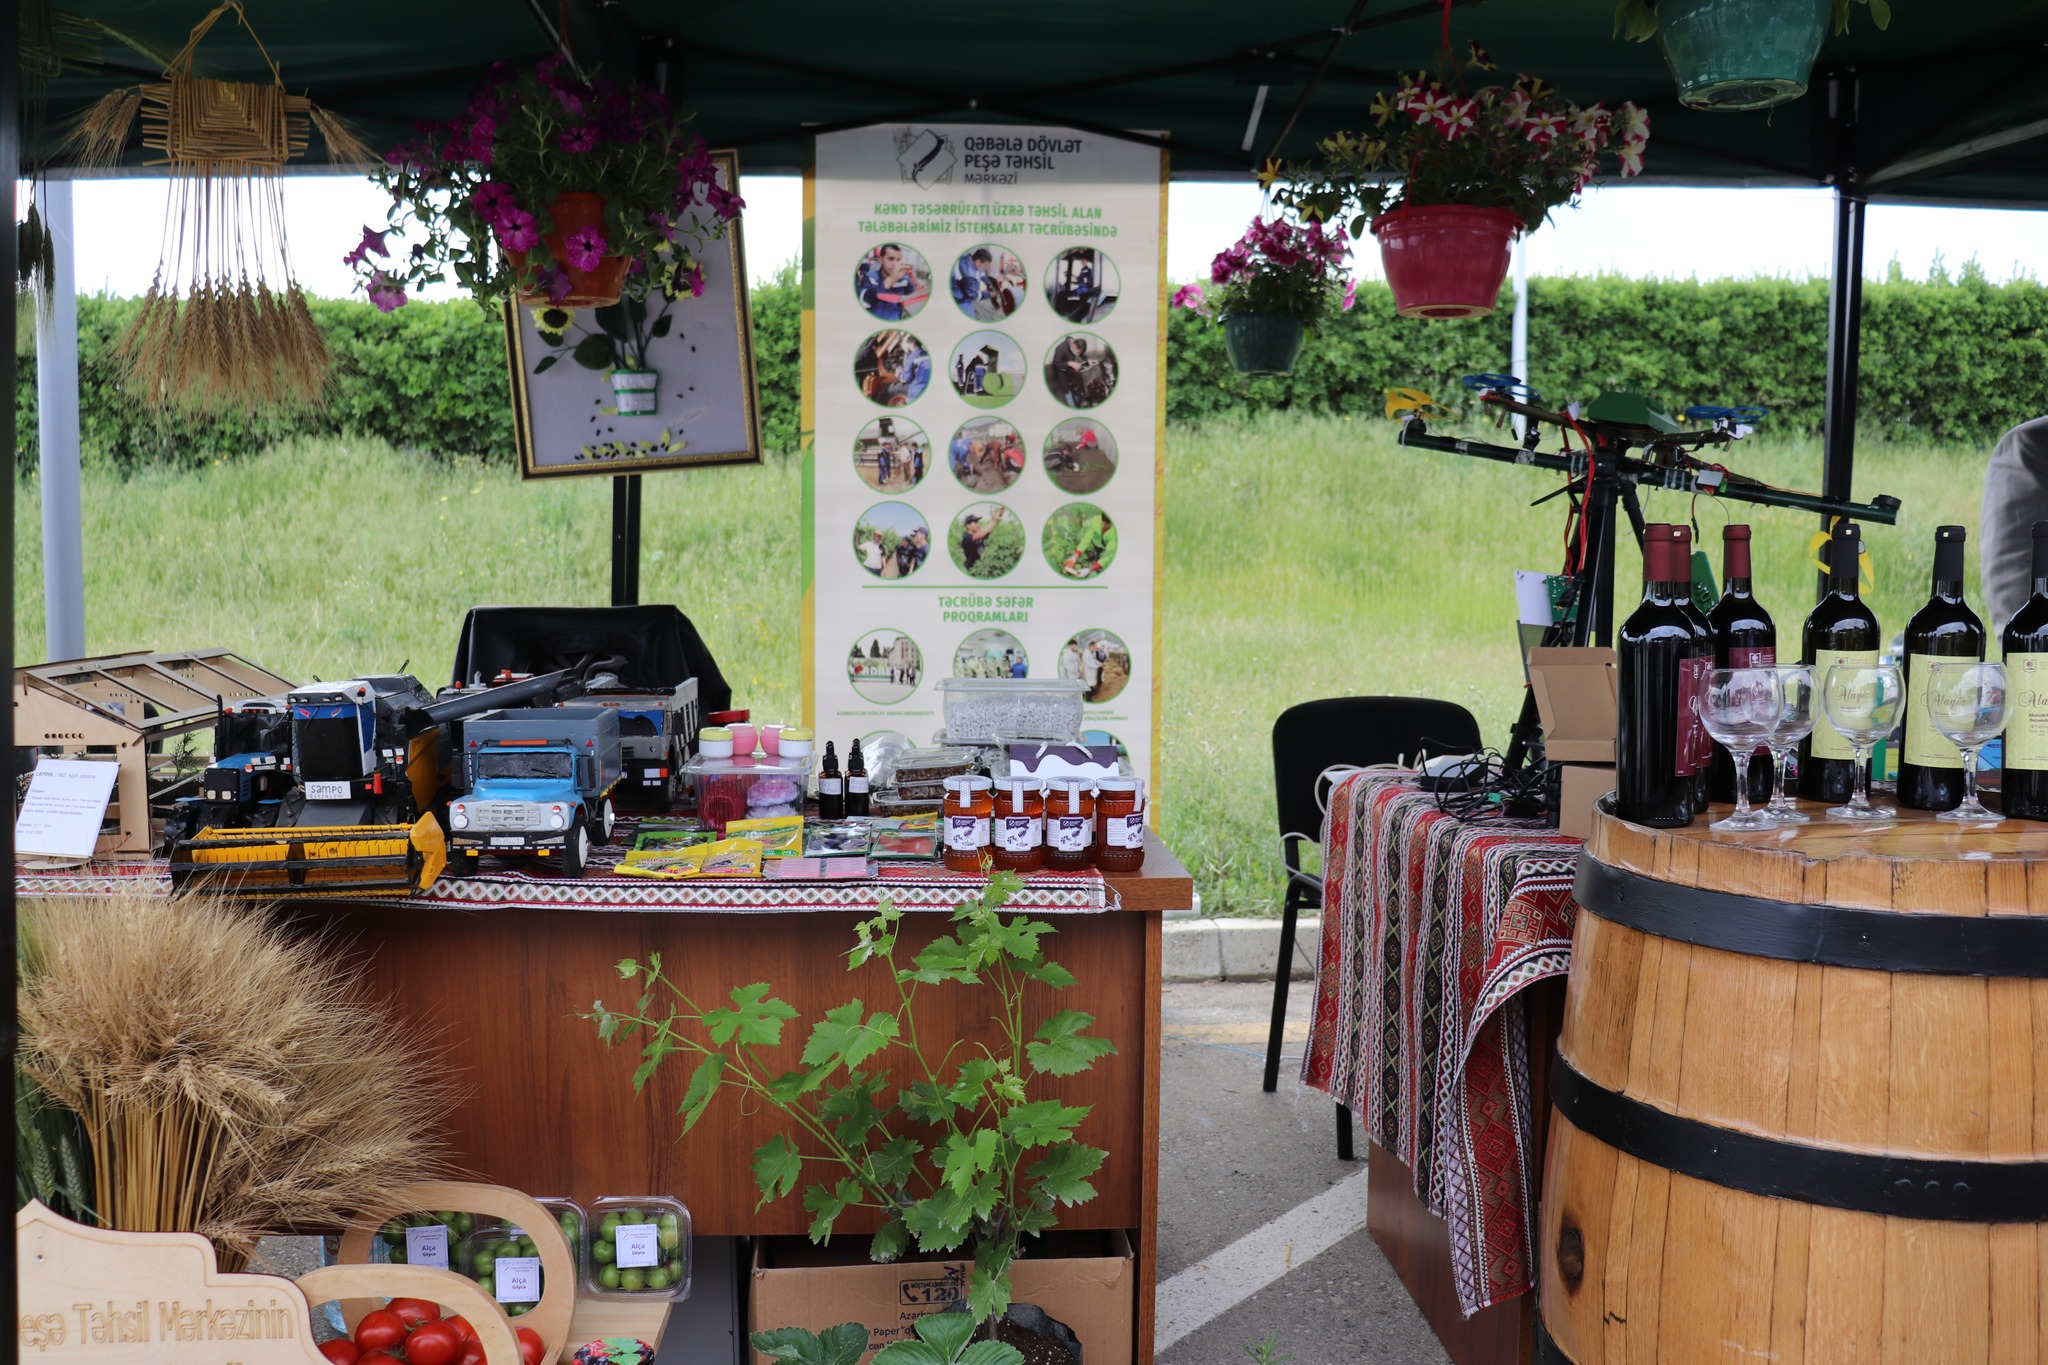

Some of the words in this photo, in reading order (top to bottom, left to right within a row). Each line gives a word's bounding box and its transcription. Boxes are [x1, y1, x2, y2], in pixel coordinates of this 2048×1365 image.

[964, 136, 1023, 152] QƏBƏLƏ
[1027, 135, 1083, 154] DÖVLƏT
[964, 154, 1001, 172] PEŞƏ
[1005, 152, 1055, 170] TƏHSİL
[964, 171, 1018, 185] MƏRKƏZİ
[873, 203, 908, 215] KƏND
[911, 200, 990, 217] TƏSƏRRÜFATI
[993, 201, 1024, 217] ÜZRƏ
[1028, 202, 1068, 218] TƏHSİL
[1072, 206, 1103, 219] ALAN
[858, 218, 952, 234] TƏLƏBƏLƏRİMİZ
[955, 218, 1025, 235] İSTEHSALAT
[1028, 221, 1118, 238] TƏCRÜBƏSİNDƏ
[938, 592, 992, 608] TƏCRÜBƏ
[995, 596, 1034, 608] SƏFƏR
[943, 610, 1029, 624] PROQRAMLARI
[422, 1244, 437, 1252] Alça
[631, 1243, 646, 1251] Alça
[511, 1277, 527, 1285] Alça
[71, 1299, 151, 1346] Təhsil
[158, 1298, 294, 1343] Mərkəzinin
